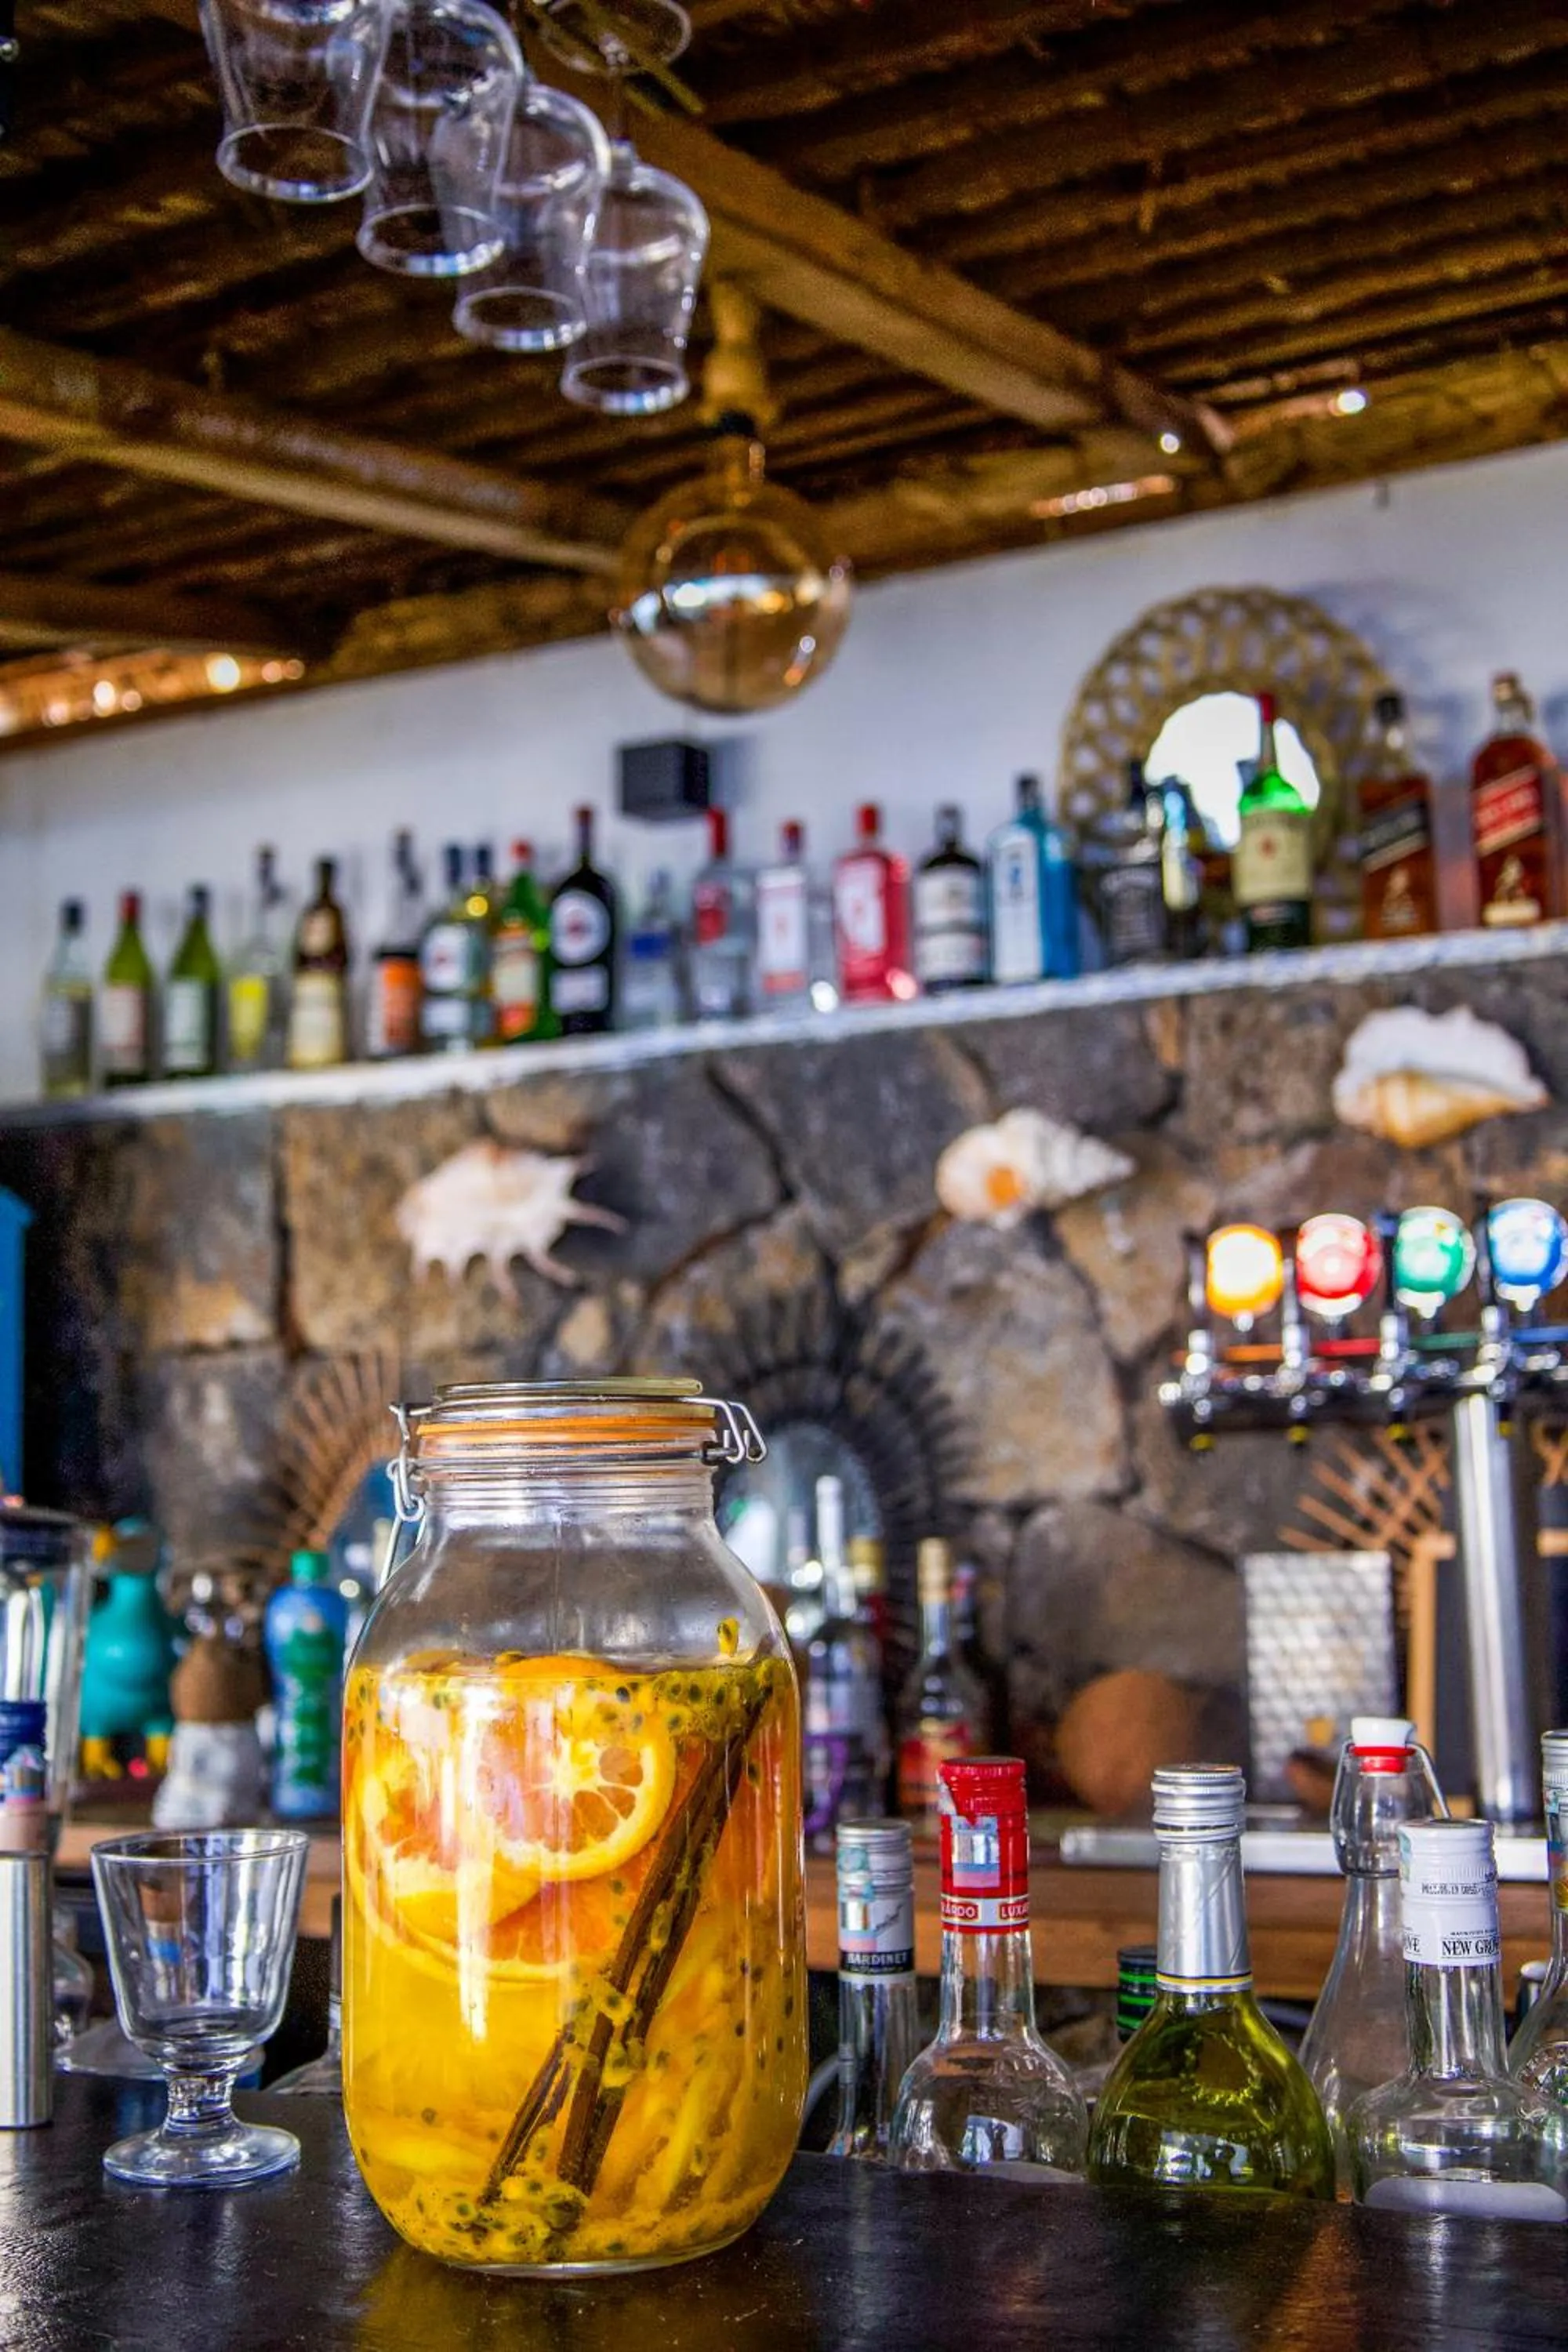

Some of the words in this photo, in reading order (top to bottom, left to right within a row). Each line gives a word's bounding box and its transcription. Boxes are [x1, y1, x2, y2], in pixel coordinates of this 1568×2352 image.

[941, 1900, 976, 1918] ARDO
[1001, 1902, 1029, 1918] LUXA
[1443, 1940, 1472, 1956] NEW
